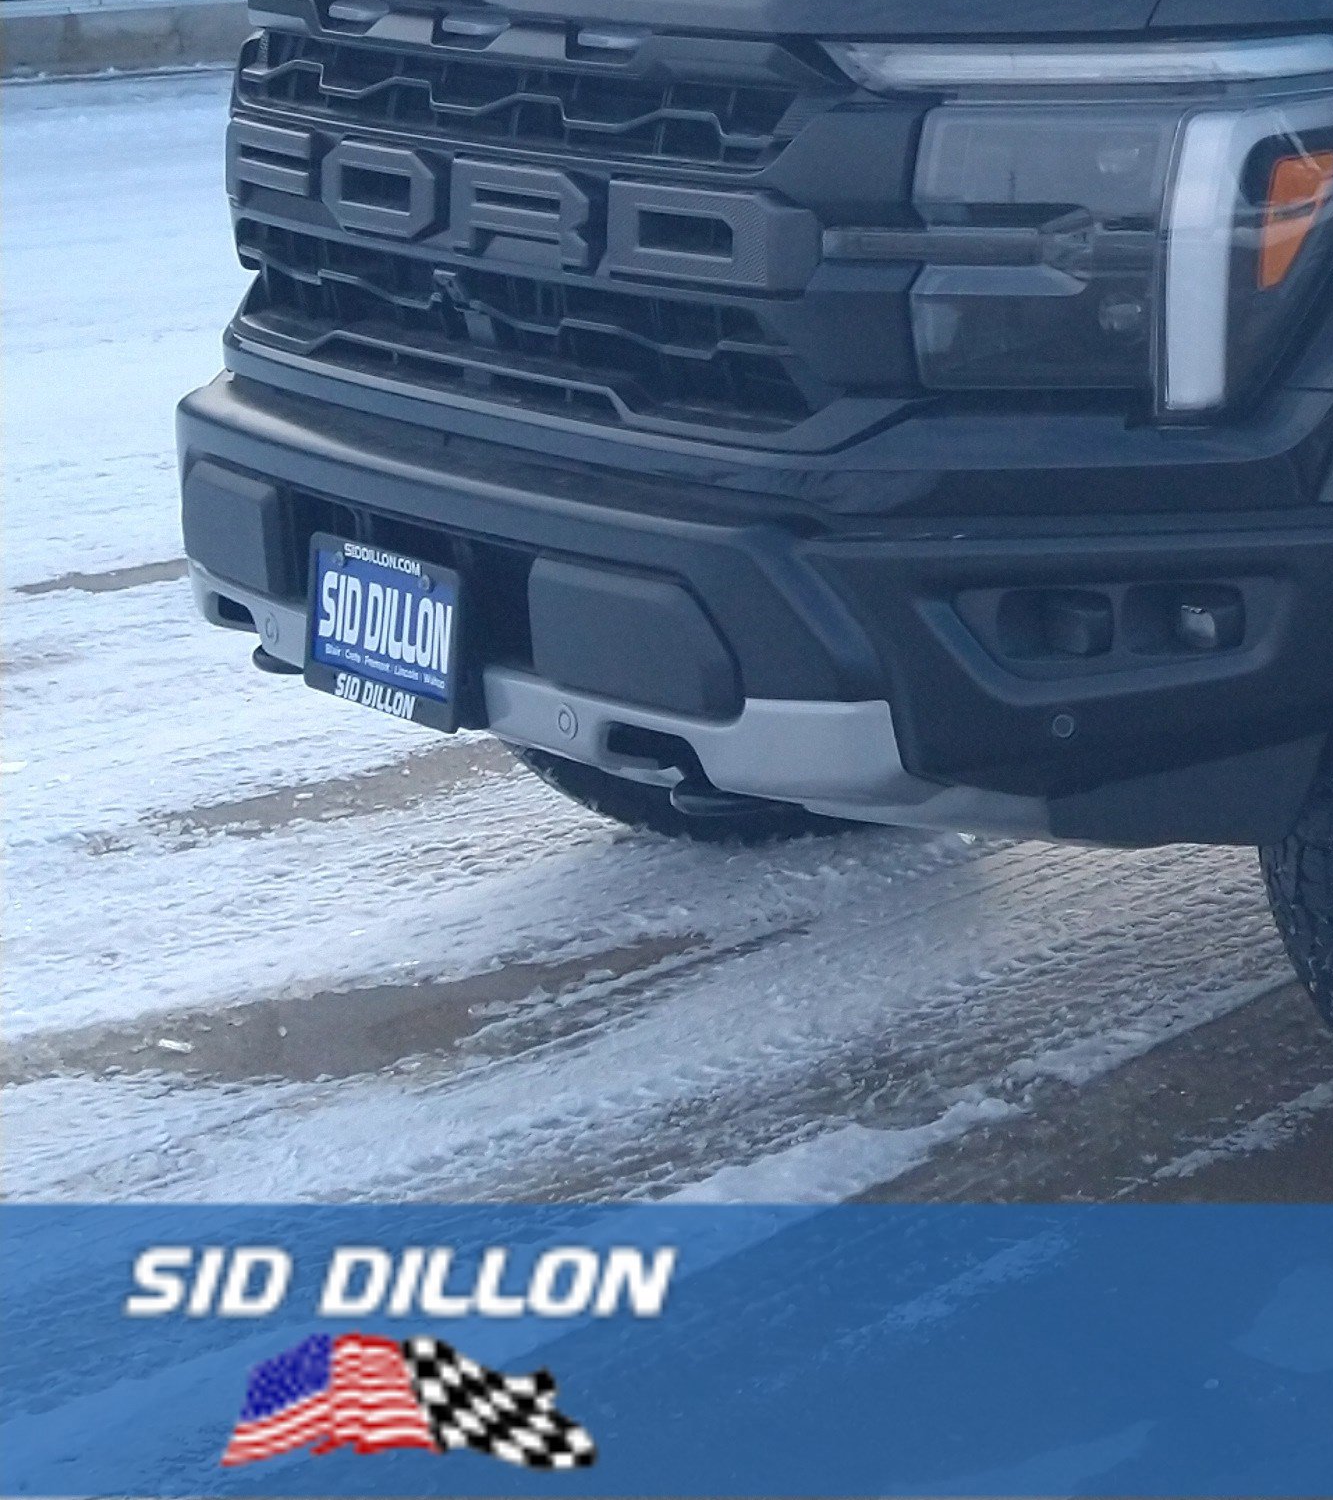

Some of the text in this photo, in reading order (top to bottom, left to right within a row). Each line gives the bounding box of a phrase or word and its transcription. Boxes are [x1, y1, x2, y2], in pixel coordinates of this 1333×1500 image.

[228, 117, 800, 298] FORD
[344, 542, 422, 578] SIDDILLON.COM
[318, 570, 453, 675] SID DILLON
[334, 672, 417, 720] SID DILLON
